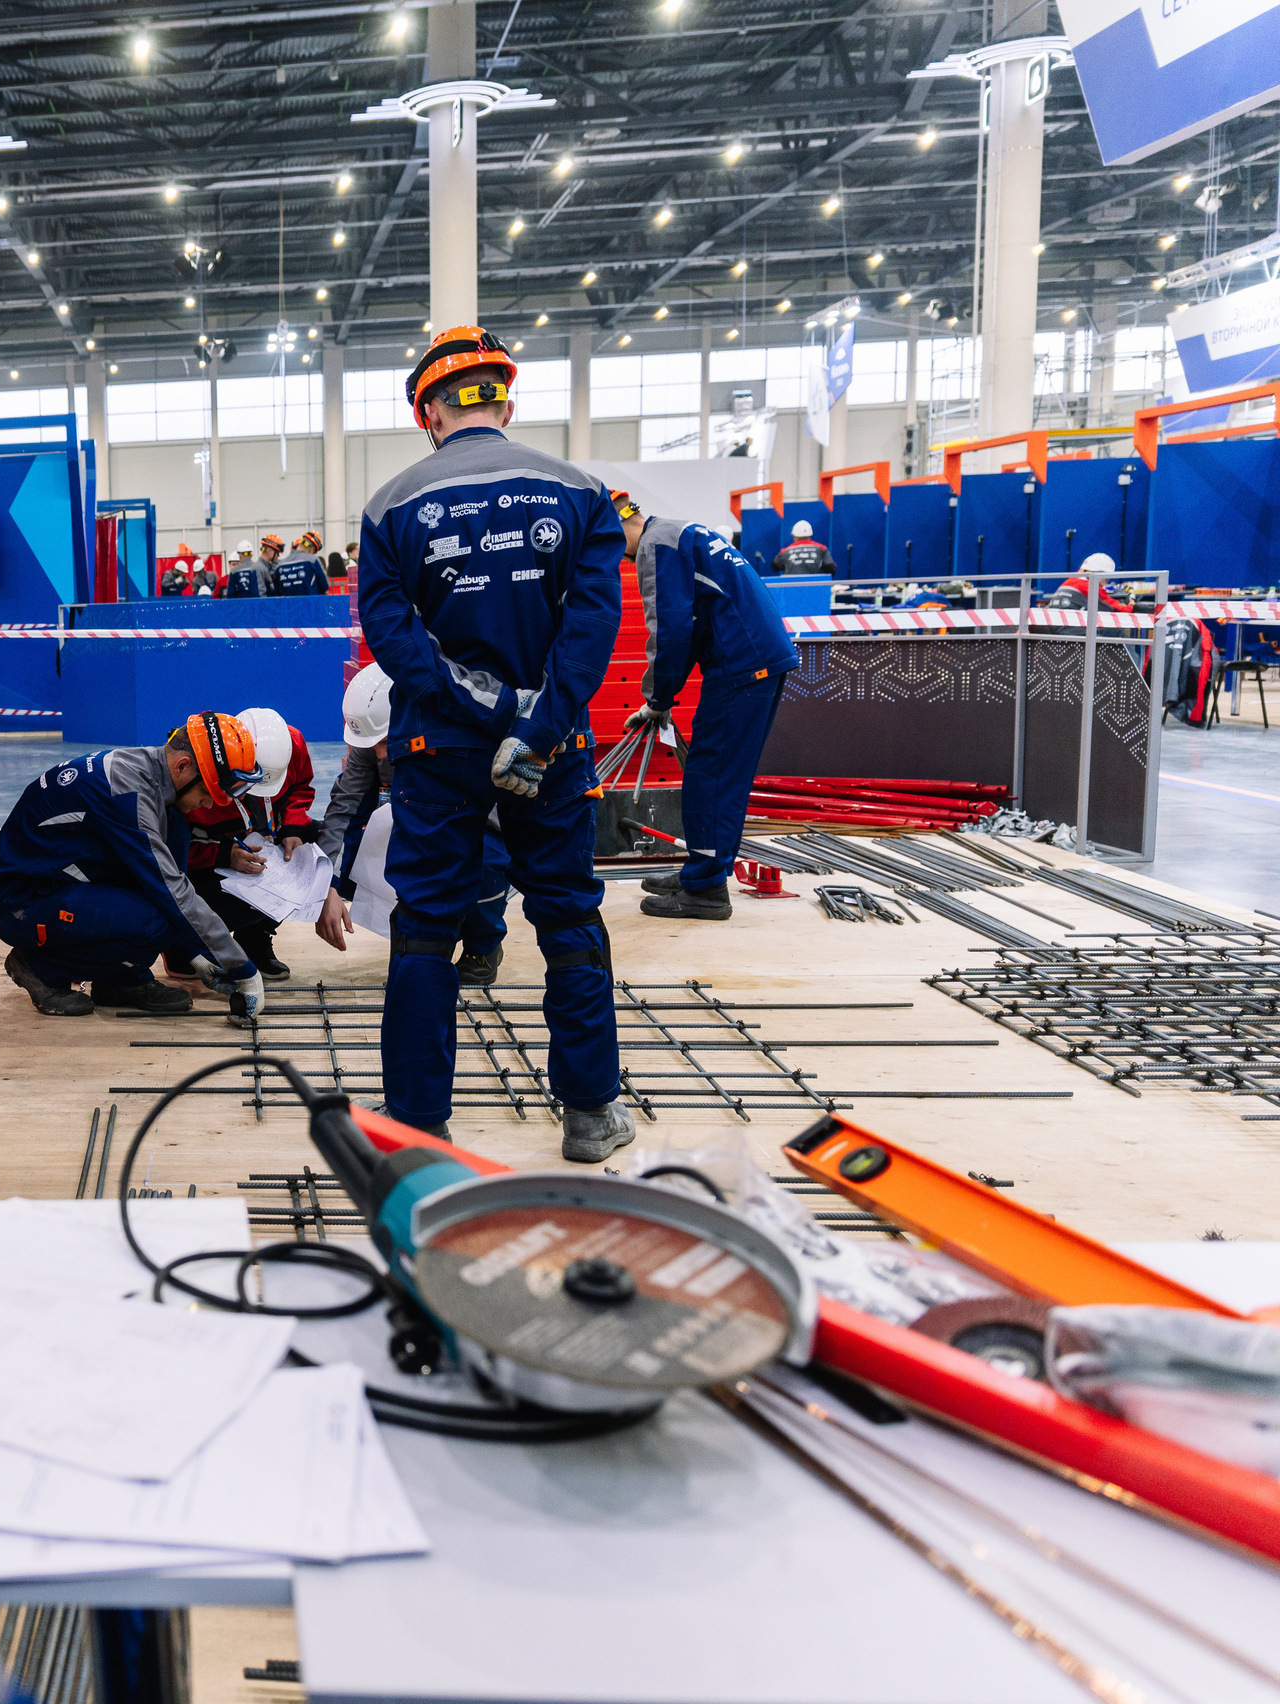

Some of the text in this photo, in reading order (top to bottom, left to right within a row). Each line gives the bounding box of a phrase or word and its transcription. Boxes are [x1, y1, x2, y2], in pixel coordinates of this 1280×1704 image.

[449, 500, 488, 512] МИНСТРОЙ
[450, 508, 479, 518] РОССИИ
[491, 530, 523, 543] ГАЗПРОМ
